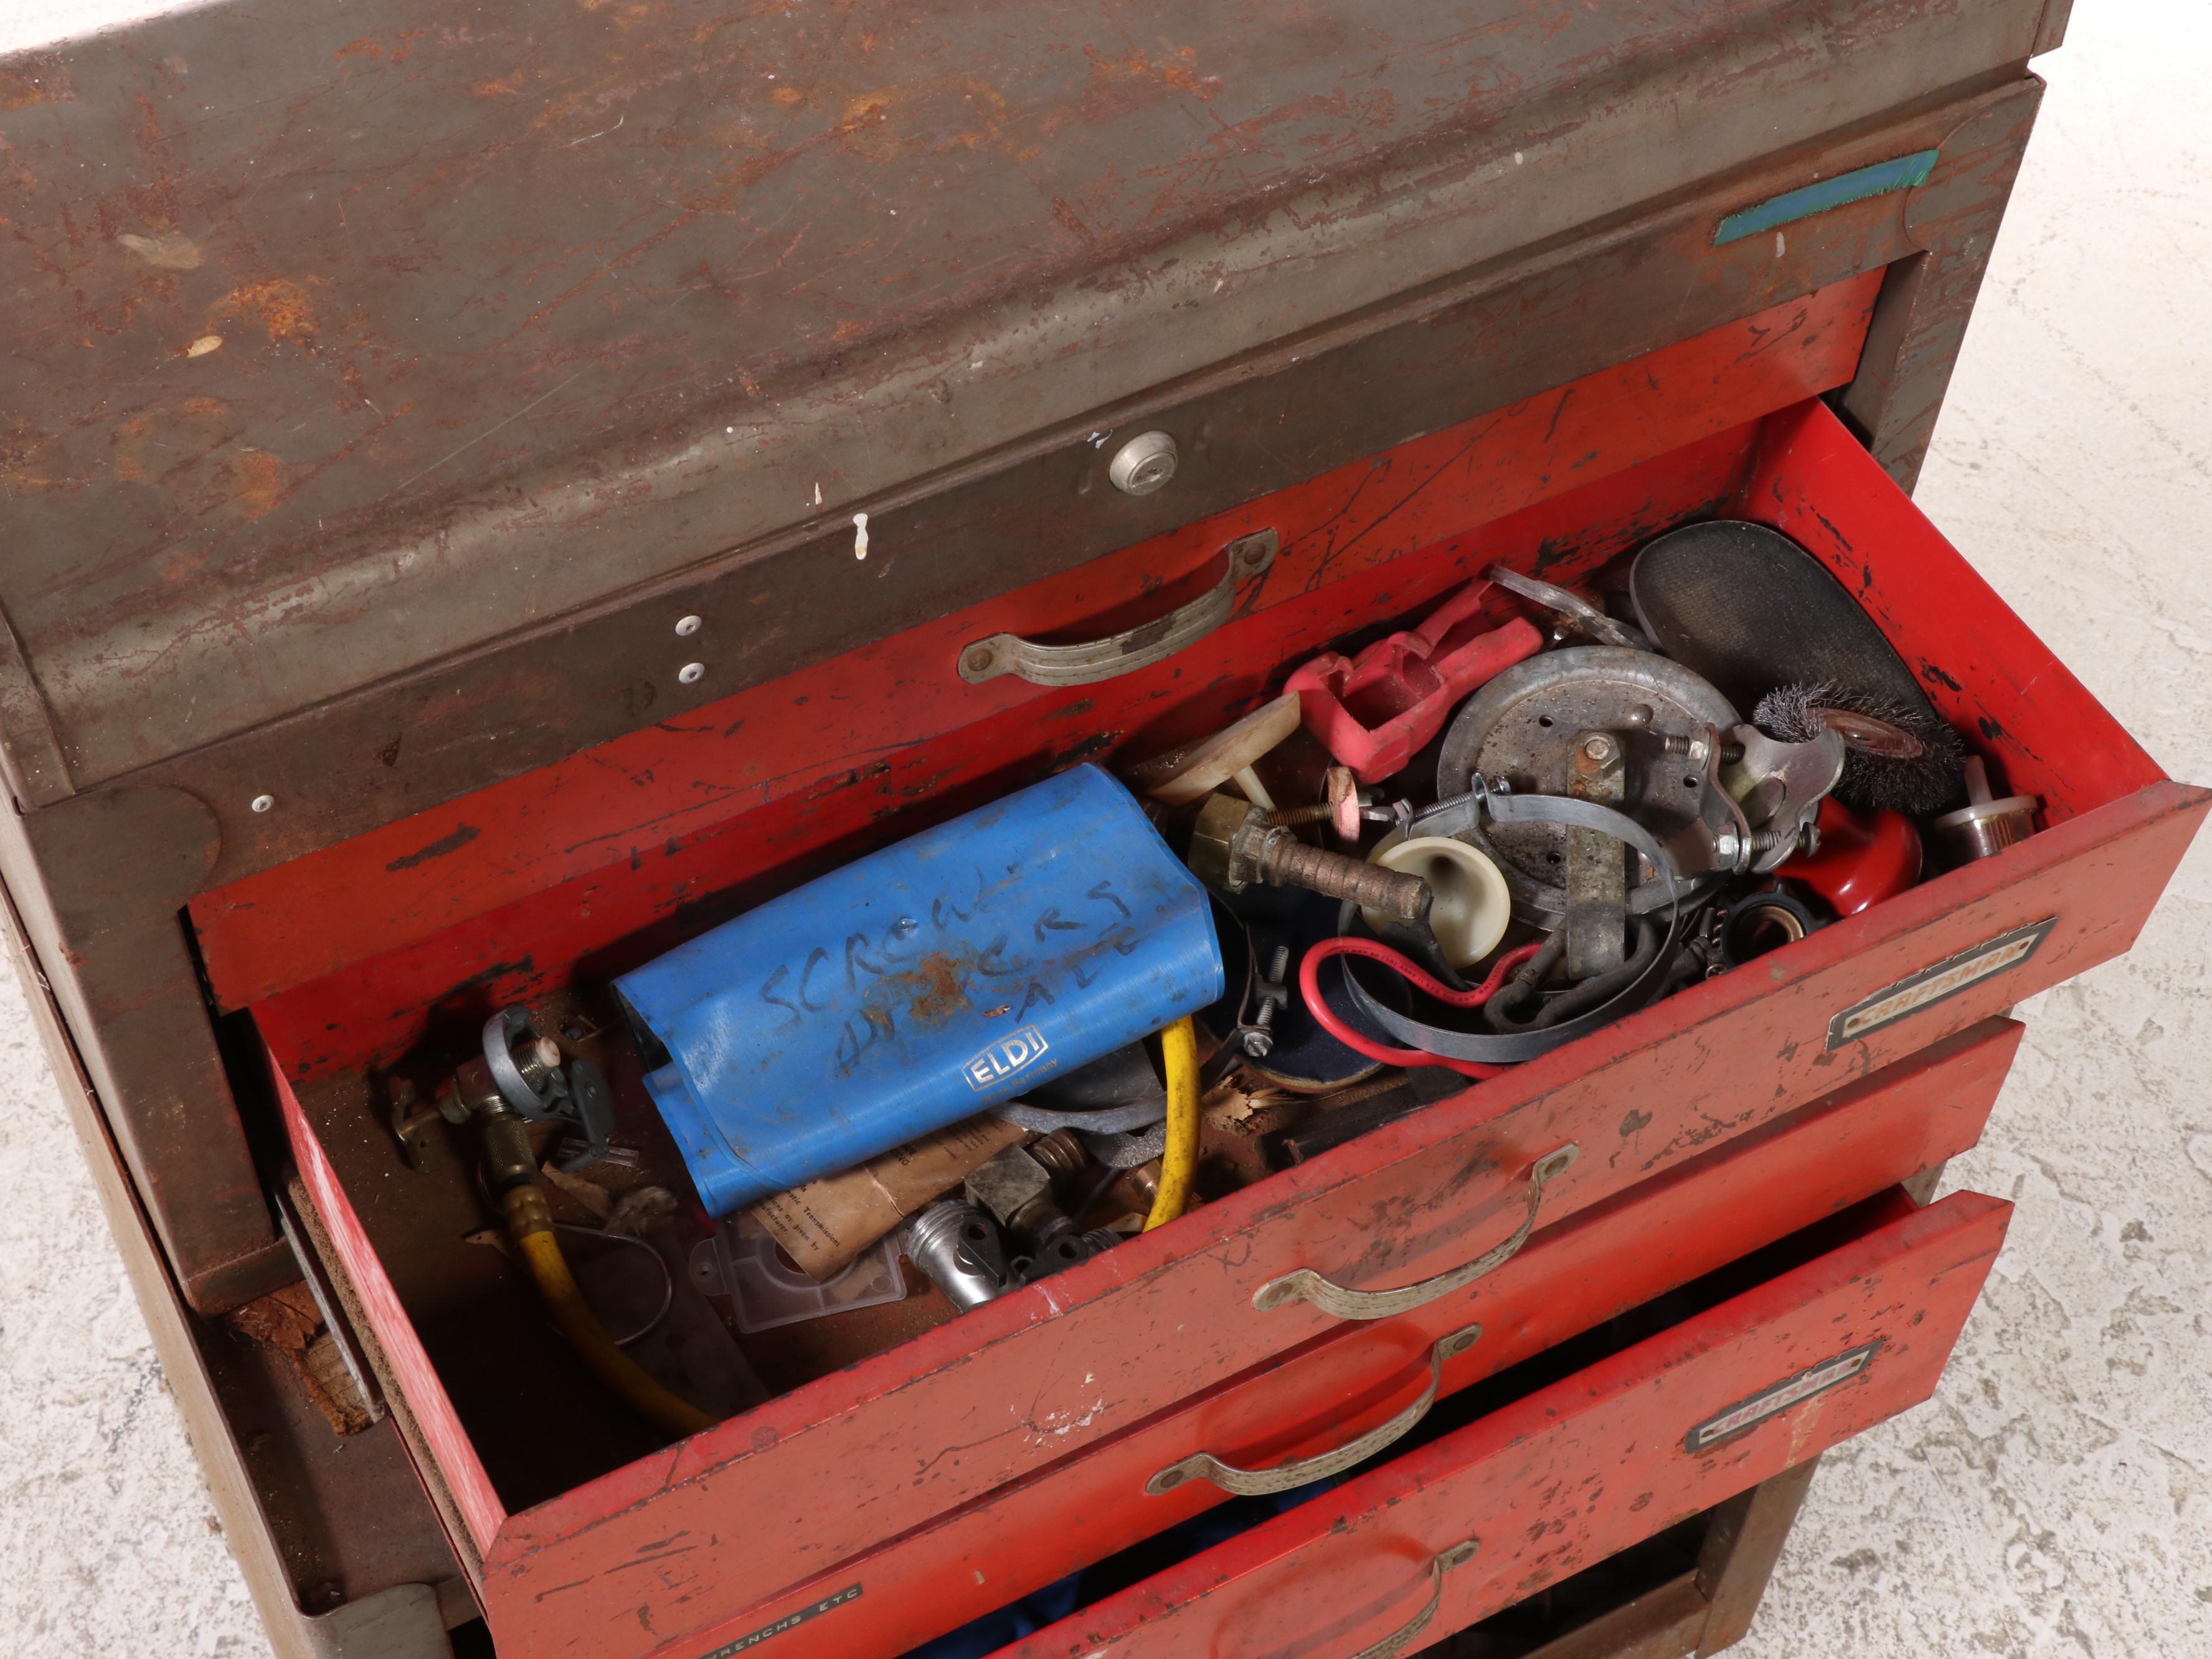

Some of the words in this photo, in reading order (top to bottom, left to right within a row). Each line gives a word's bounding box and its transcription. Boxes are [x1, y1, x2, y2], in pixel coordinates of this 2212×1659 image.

[1856, 943, 2021, 1026] CRAFTSMAN
[970, 1032, 1039, 1084] ELDI
[1011, 1058, 1057, 1087] Germany
[792, 1224, 810, 1241] given
[811, 1241, 820, 1251] by
[803, 1206, 841, 1247] Transmissions
[818, 1589, 858, 1612] ETC
